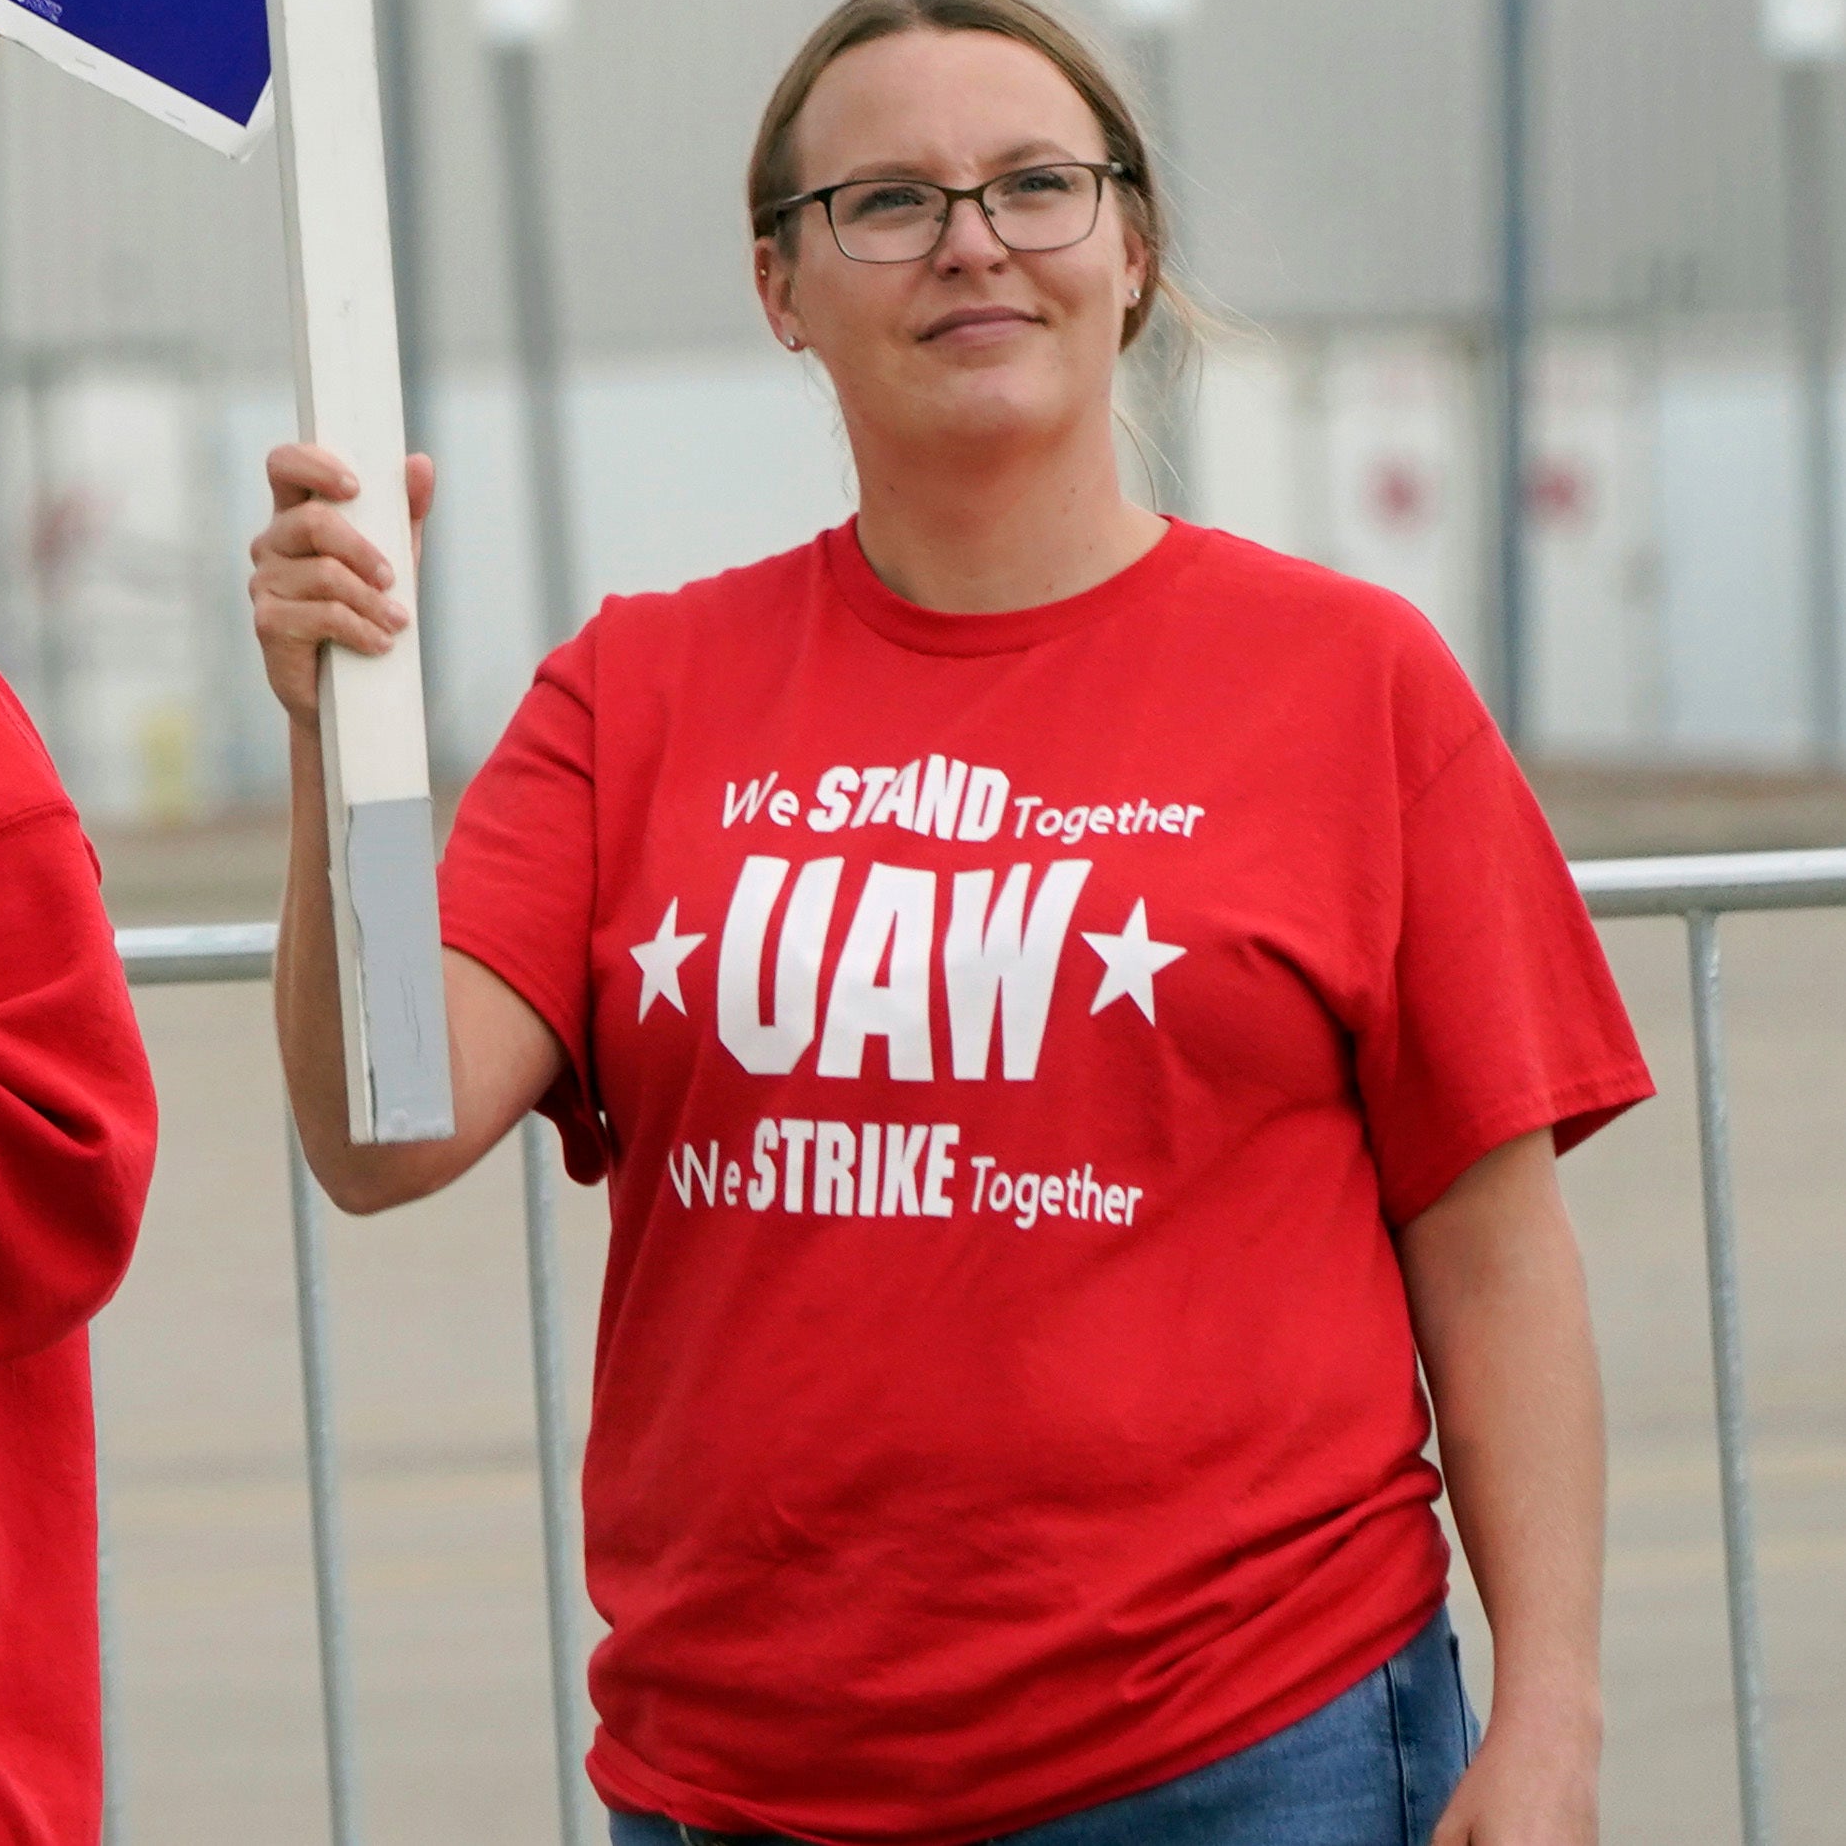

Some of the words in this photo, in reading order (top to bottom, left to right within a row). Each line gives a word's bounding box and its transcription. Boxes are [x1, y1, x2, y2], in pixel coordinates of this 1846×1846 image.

[722, 770, 801, 830] We
[807, 753, 1011, 843] STAND
[1012, 794, 1206, 845] Together
[716, 853, 1094, 1082] UAW
[667, 1140, 742, 1209] We
[746, 1117, 961, 1219] STRIKE
[969, 1154, 1144, 1230] Together
